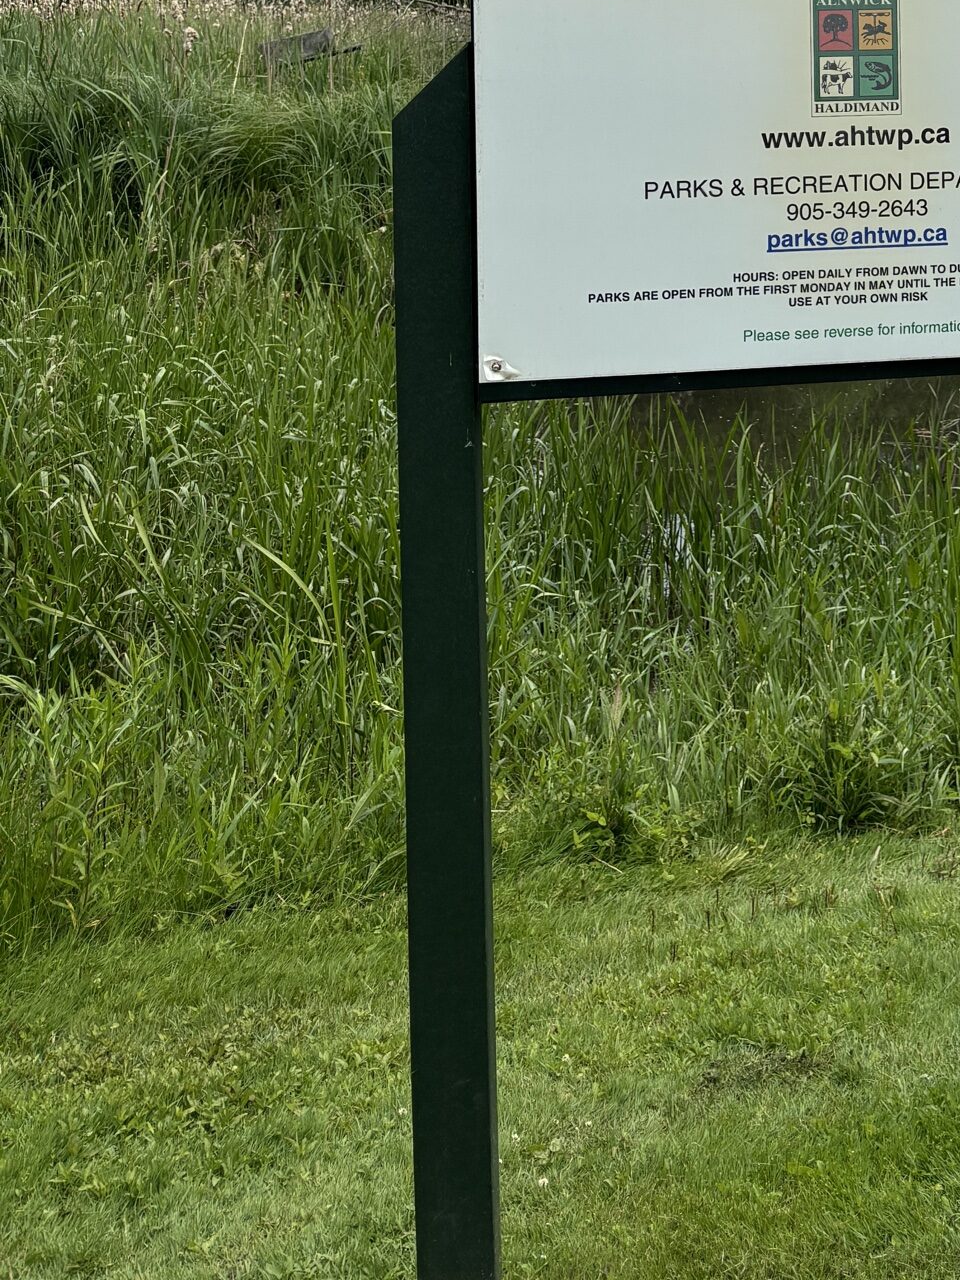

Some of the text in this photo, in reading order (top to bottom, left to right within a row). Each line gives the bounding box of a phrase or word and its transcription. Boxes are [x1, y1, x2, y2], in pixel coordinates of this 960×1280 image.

[815, 102, 899, 113] HALDIMAND
[761, 125, 950, 150] www.ahtwp.ca
[645, 179, 723, 199] PARKS
[731, 179, 745, 196] &
[754, 173, 901, 195] RECREATION
[787, 199, 928, 221] 905-349-2643
[767, 227, 948, 253] parks@ahtwp.ca
[733, 272, 778, 283] HOURS:
[782, 270, 814, 280] OPEN
[818, 268, 852, 279] DAILY
[856, 267, 889, 277] FROM
[893, 265, 927, 275] DAWN
[930, 264, 946, 274] TO
[588, 292, 630, 303] PARKS
[634, 291, 658, 301] ARE
[662, 289, 695, 299] OPEN
[699, 287, 733, 298] FROM
[736, 286, 760, 296] THE
[764, 284, 797, 295] FIRST
[800, 282, 851, 293] MONDAY
[854, 281, 865, 290] IN
[869, 280, 894, 290] MAY
[898, 279, 930, 289] UNTIL
[933, 277, 956, 287] THE
[789, 292, 928, 307] USE AT YOUR OWN RISK
[744, 330, 790, 342] Please
[795, 330, 819, 339] see
[824, 327, 873, 338] reverse
[878, 323, 895, 335] for
